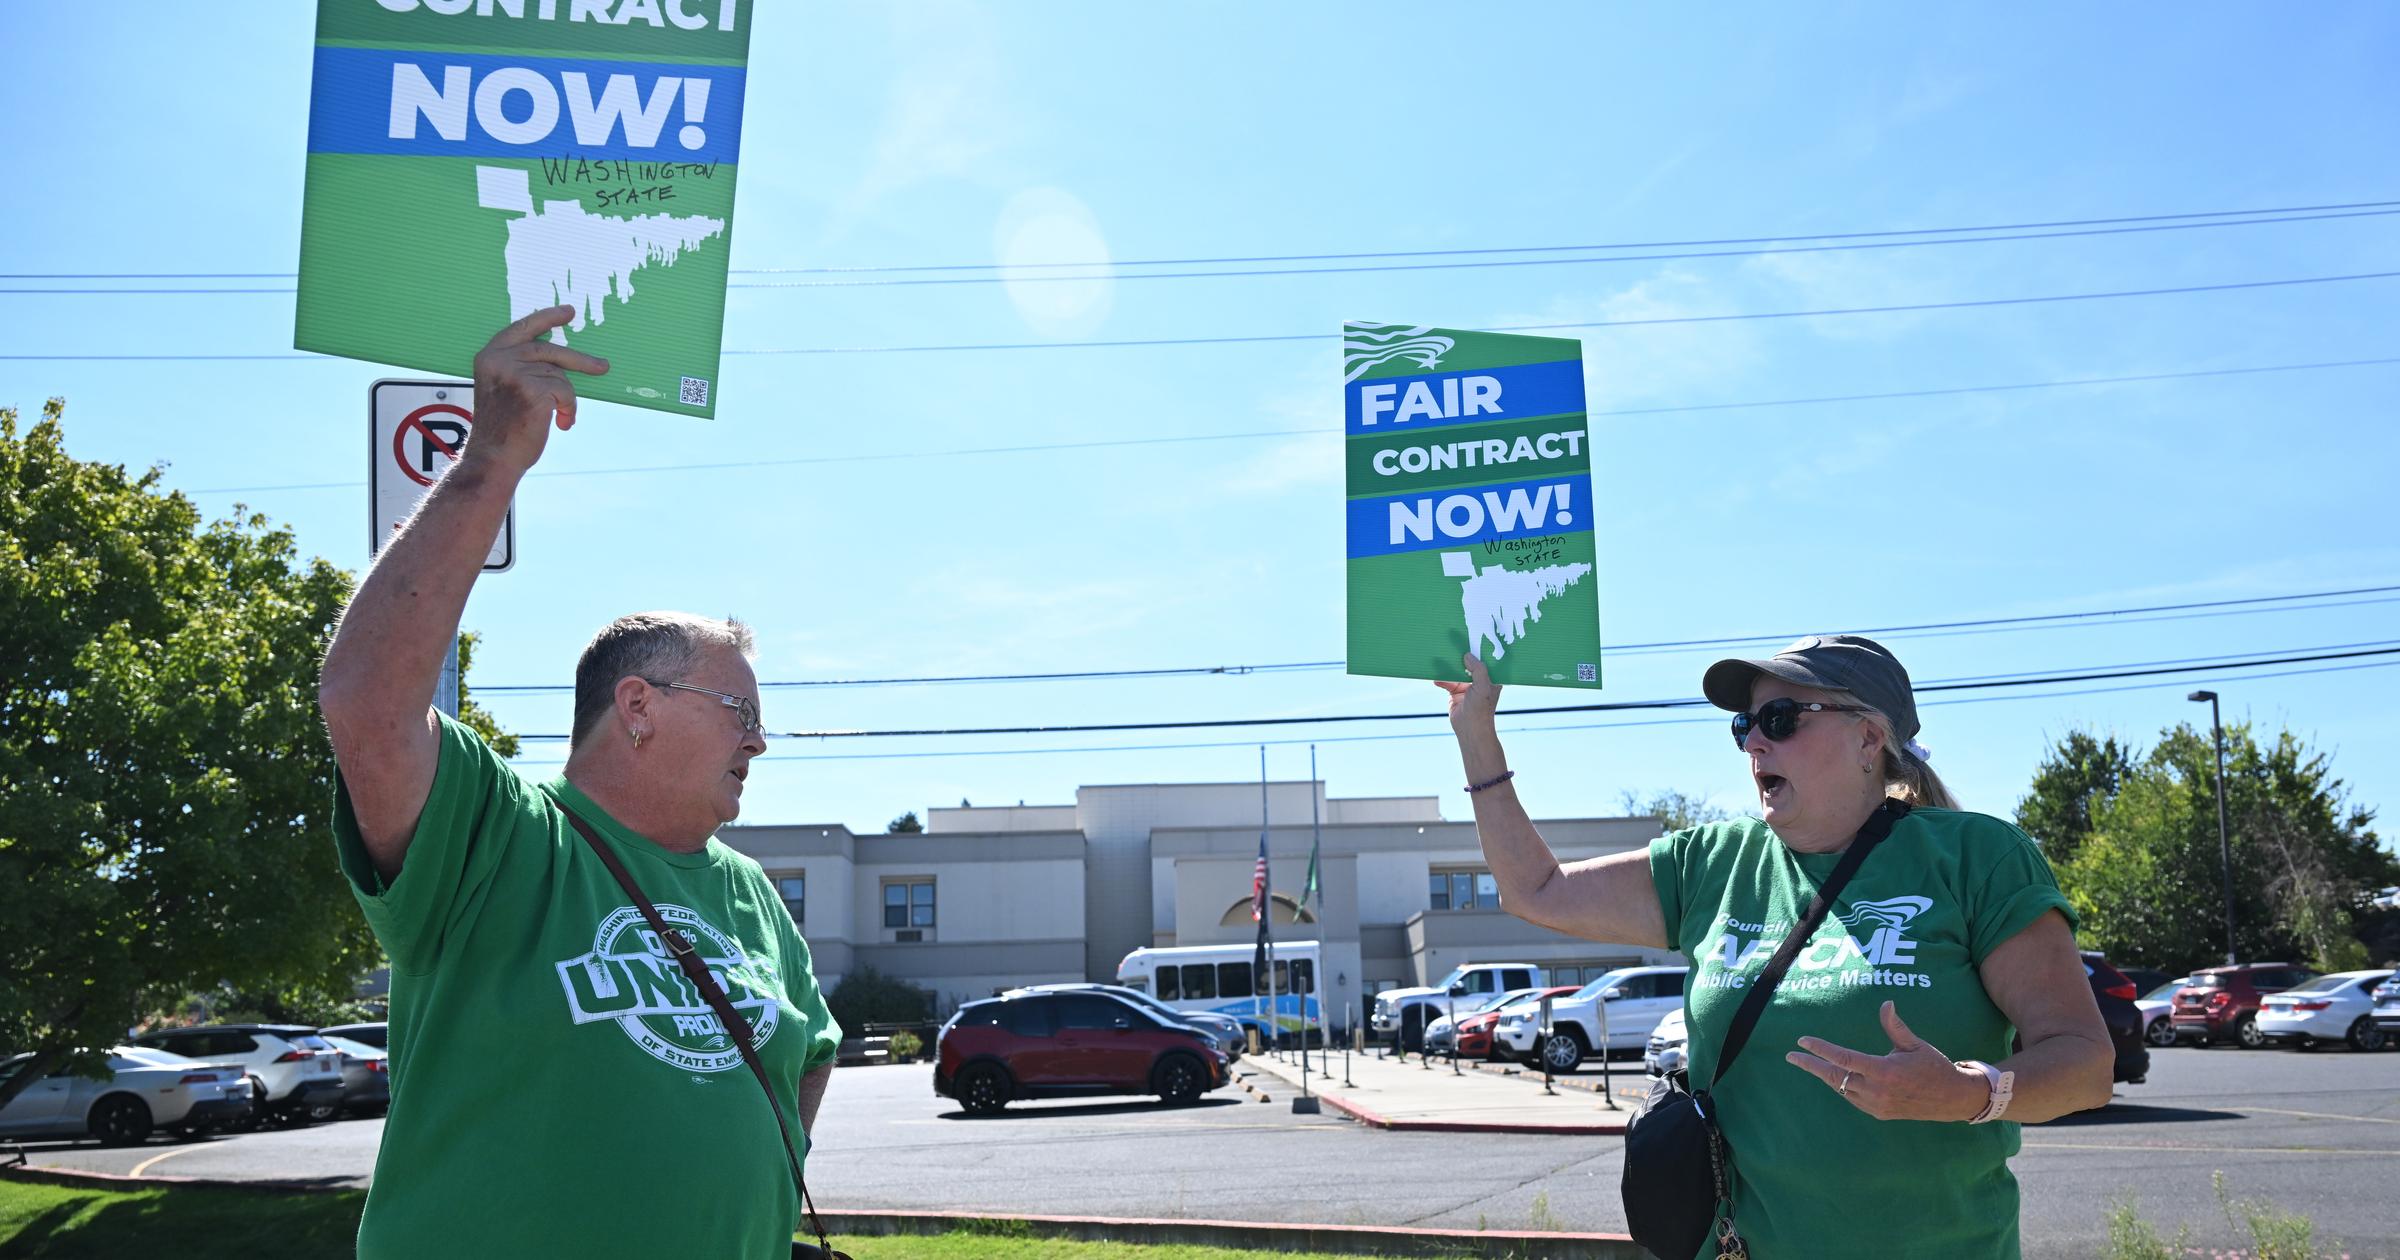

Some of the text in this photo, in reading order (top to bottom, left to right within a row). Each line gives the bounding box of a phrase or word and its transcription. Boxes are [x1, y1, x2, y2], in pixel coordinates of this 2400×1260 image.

[388, 62, 712, 151] NOW!
[541, 153, 719, 186] WASHINGTON
[595, 185, 677, 208] STATE
[1361, 375, 1504, 426] FAIR
[1372, 430, 1586, 476] CONTRACT
[1388, 484, 1573, 545] NOW!
[1483, 535, 1566, 555] Washington
[1515, 549, 1561, 566] STATE
[1718, 912, 1788, 933] Council
[1704, 927, 1918, 971] AFCME
[1839, 967, 1932, 988] Matters
[672, 1013, 731, 1037] PROU
[641, 1019, 773, 1068] OF STATE EMPLOEES
